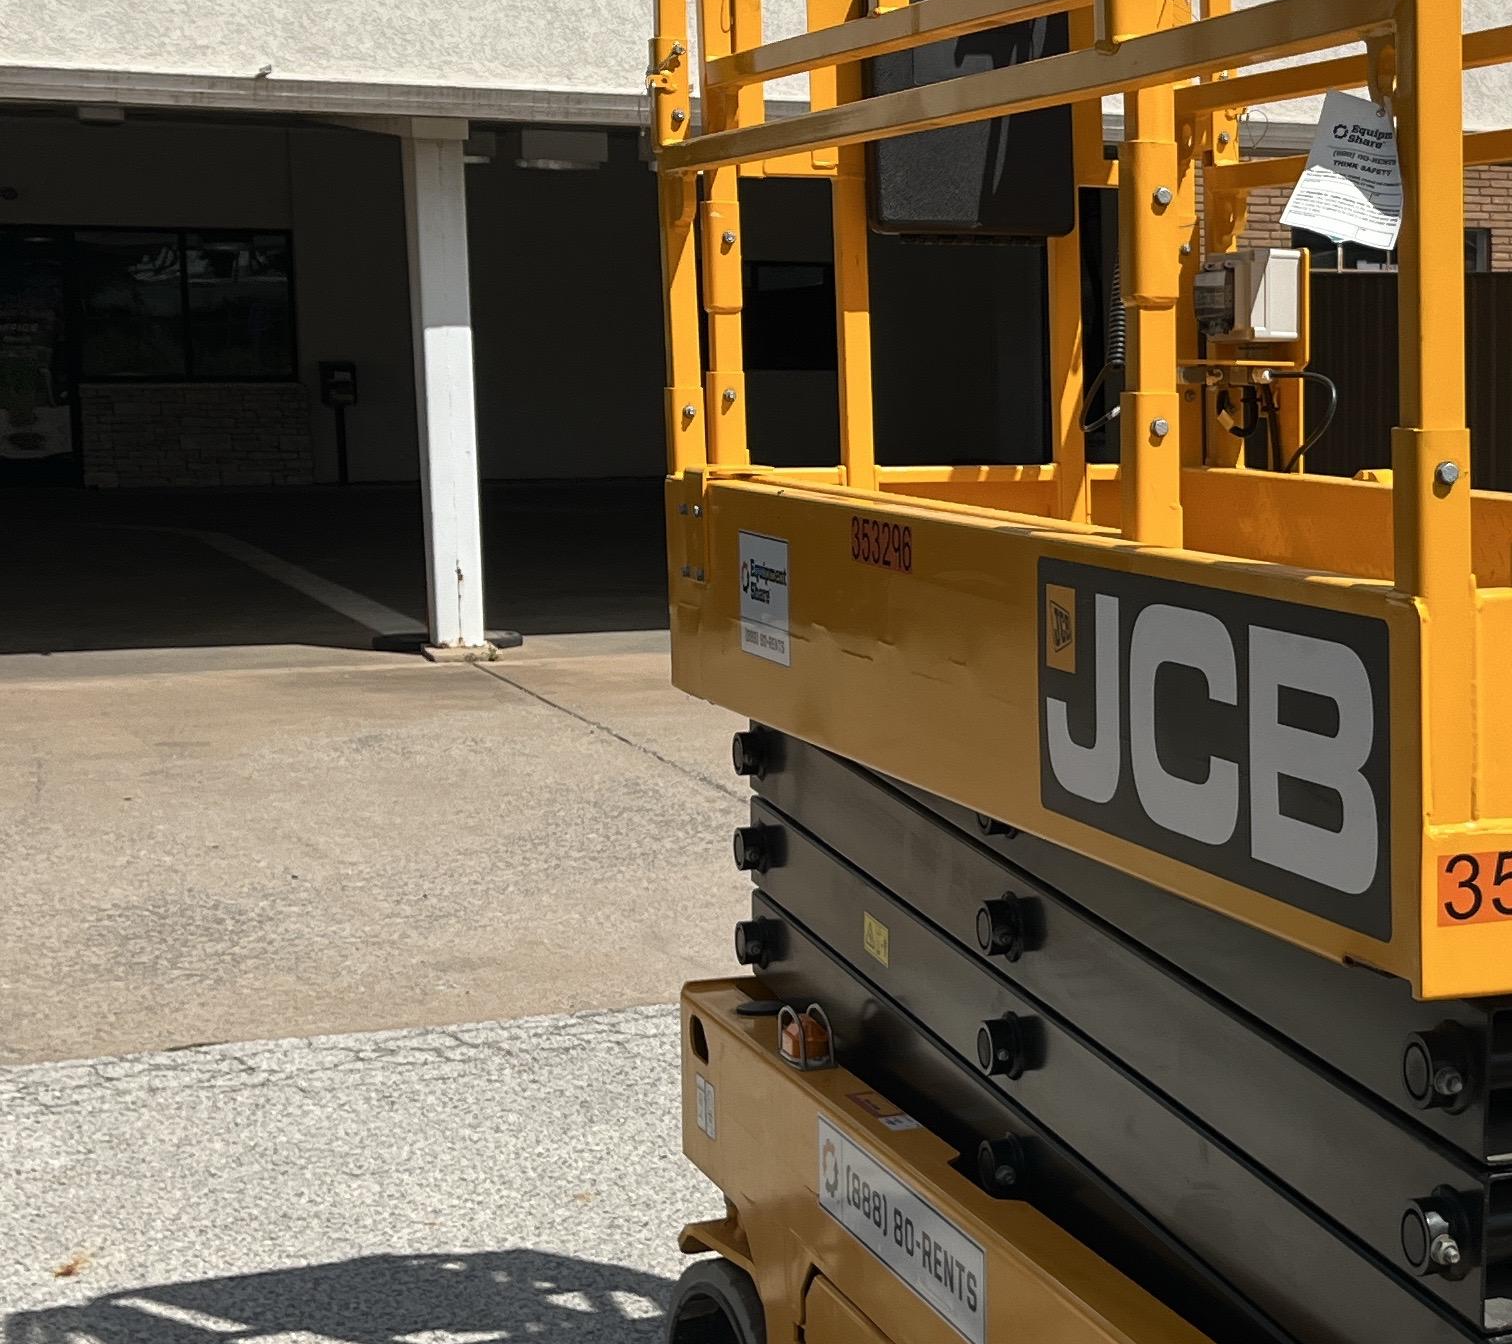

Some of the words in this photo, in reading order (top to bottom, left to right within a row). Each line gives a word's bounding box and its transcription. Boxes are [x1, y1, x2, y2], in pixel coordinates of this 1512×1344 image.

[750, 558, 787, 586] Equipment
[851, 516, 912, 572] 353296
[1046, 593, 1379, 895] JCB
[846, 1164, 888, 1238] (888)
[893, 1207, 978, 1313] 80-RENTS
